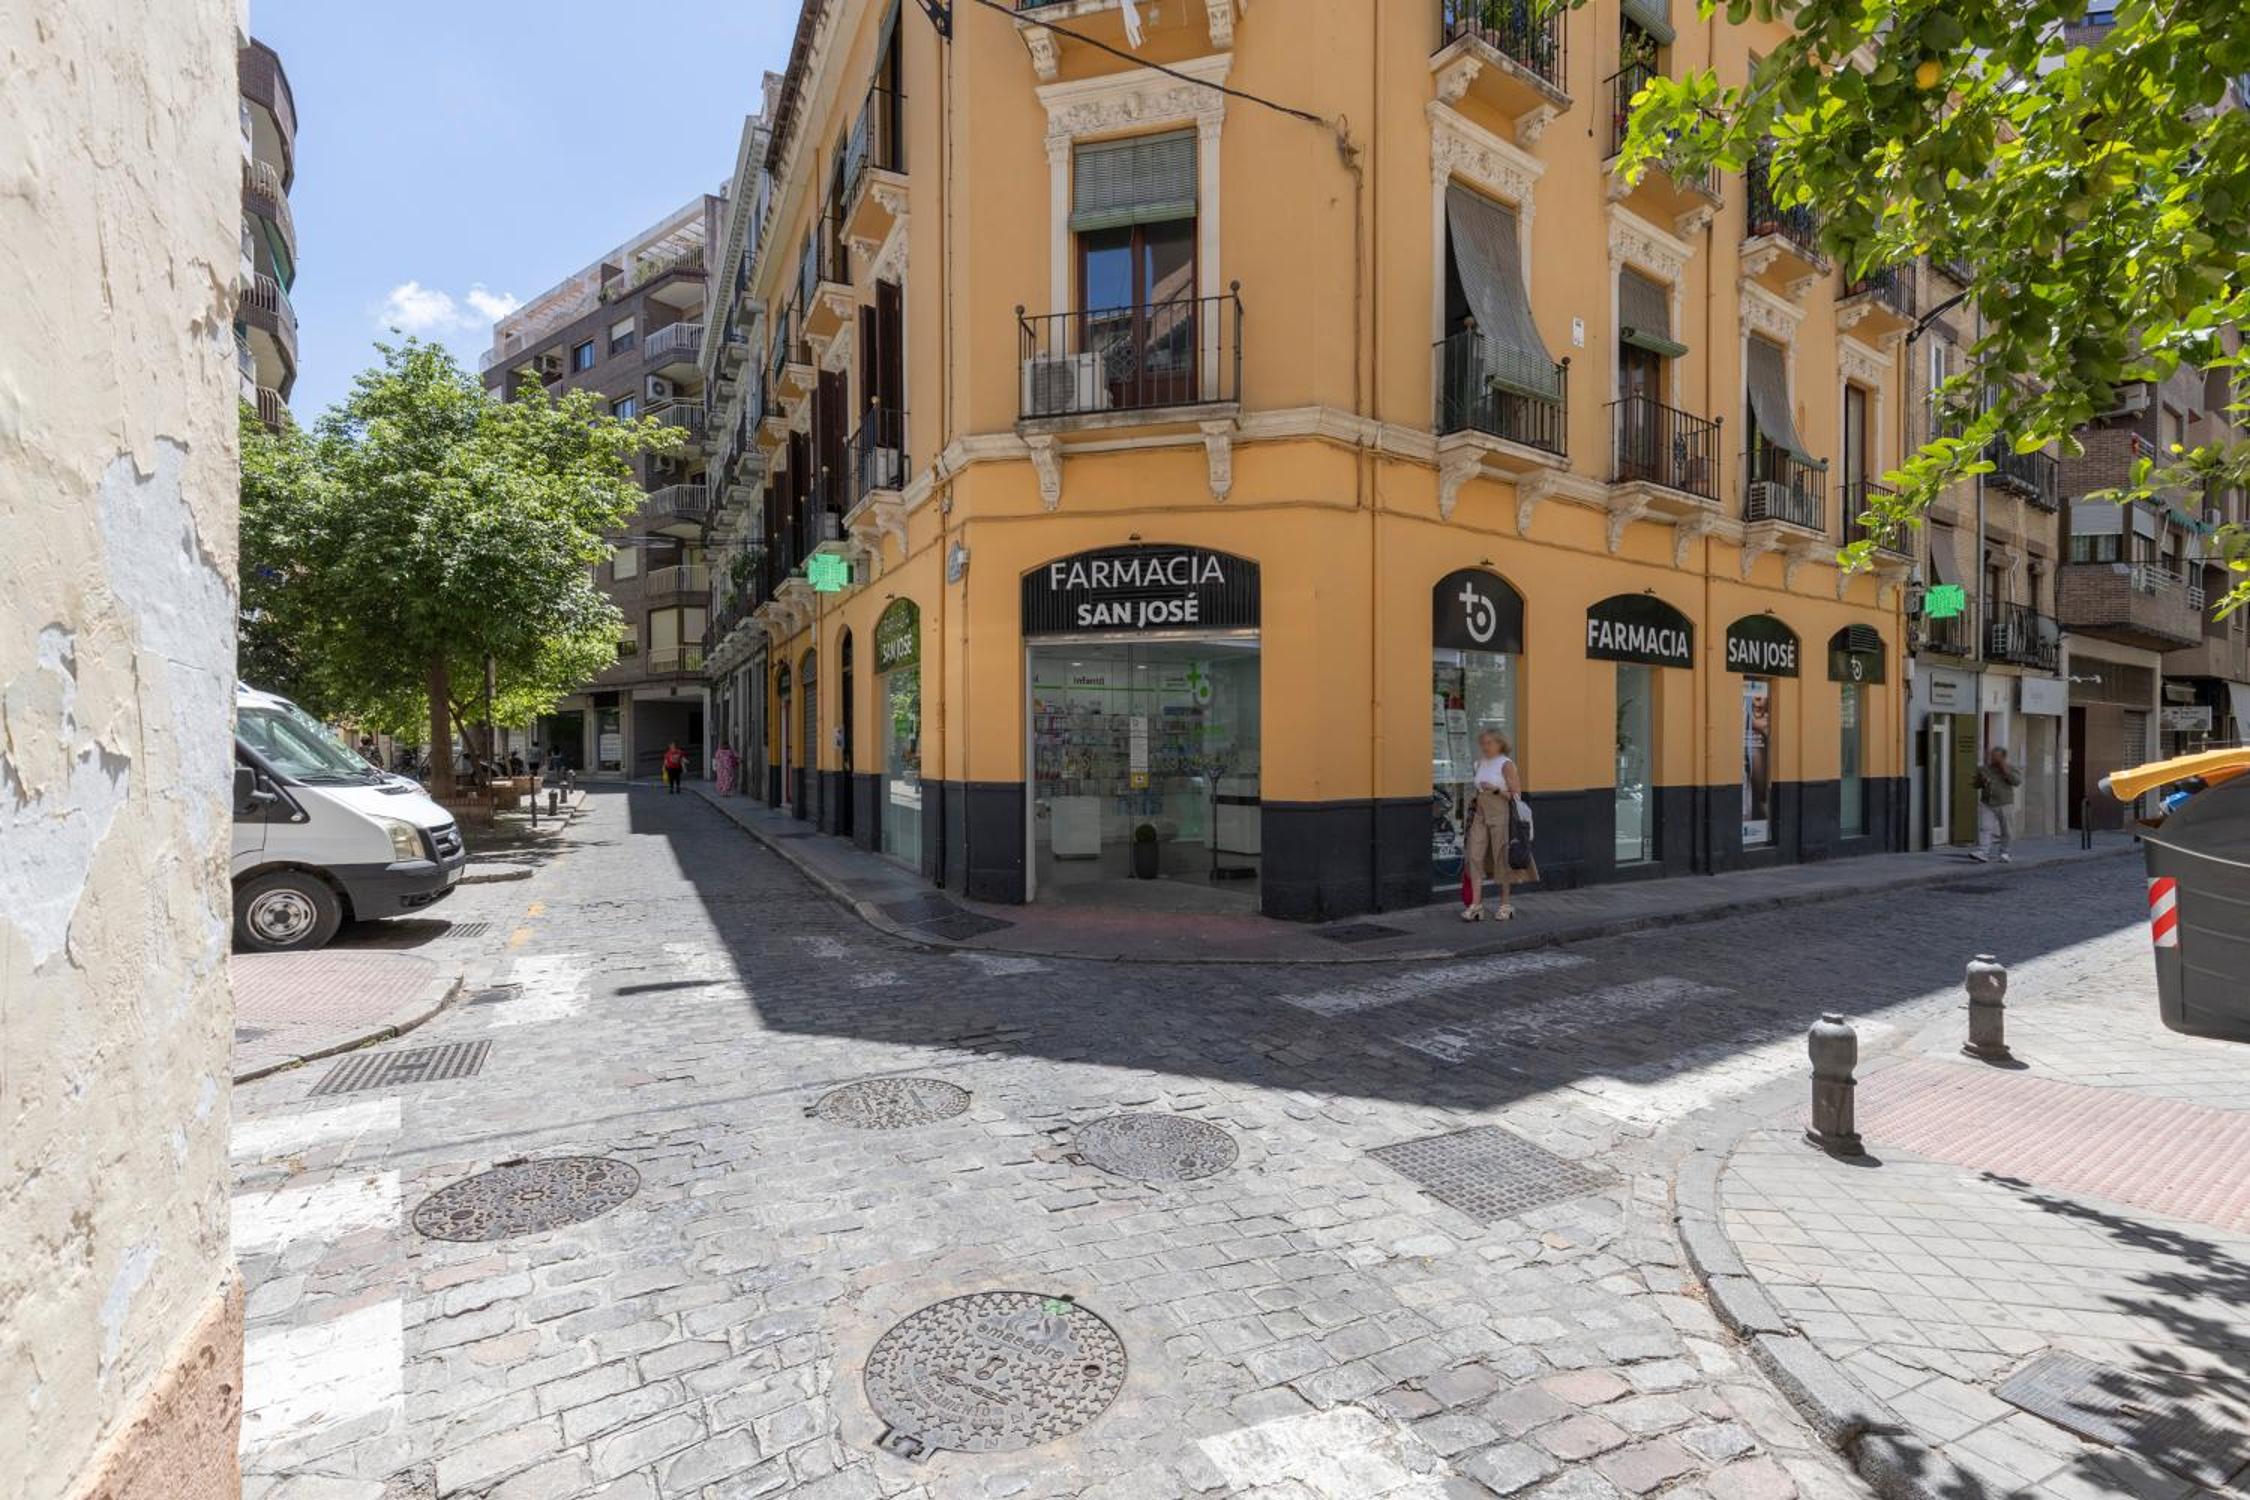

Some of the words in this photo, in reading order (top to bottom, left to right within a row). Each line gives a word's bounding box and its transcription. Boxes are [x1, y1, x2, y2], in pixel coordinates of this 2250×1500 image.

[1050, 555, 1225, 591] FARMACIA
[1077, 602, 1132, 626] SAN
[1138, 594, 1199, 628] JOSÉ
[882, 641, 896, 663] SAN
[1587, 619, 1689, 659] FARMACIA
[1728, 637, 1761, 665] SAN
[1763, 639, 1795, 671] JOSÉ
